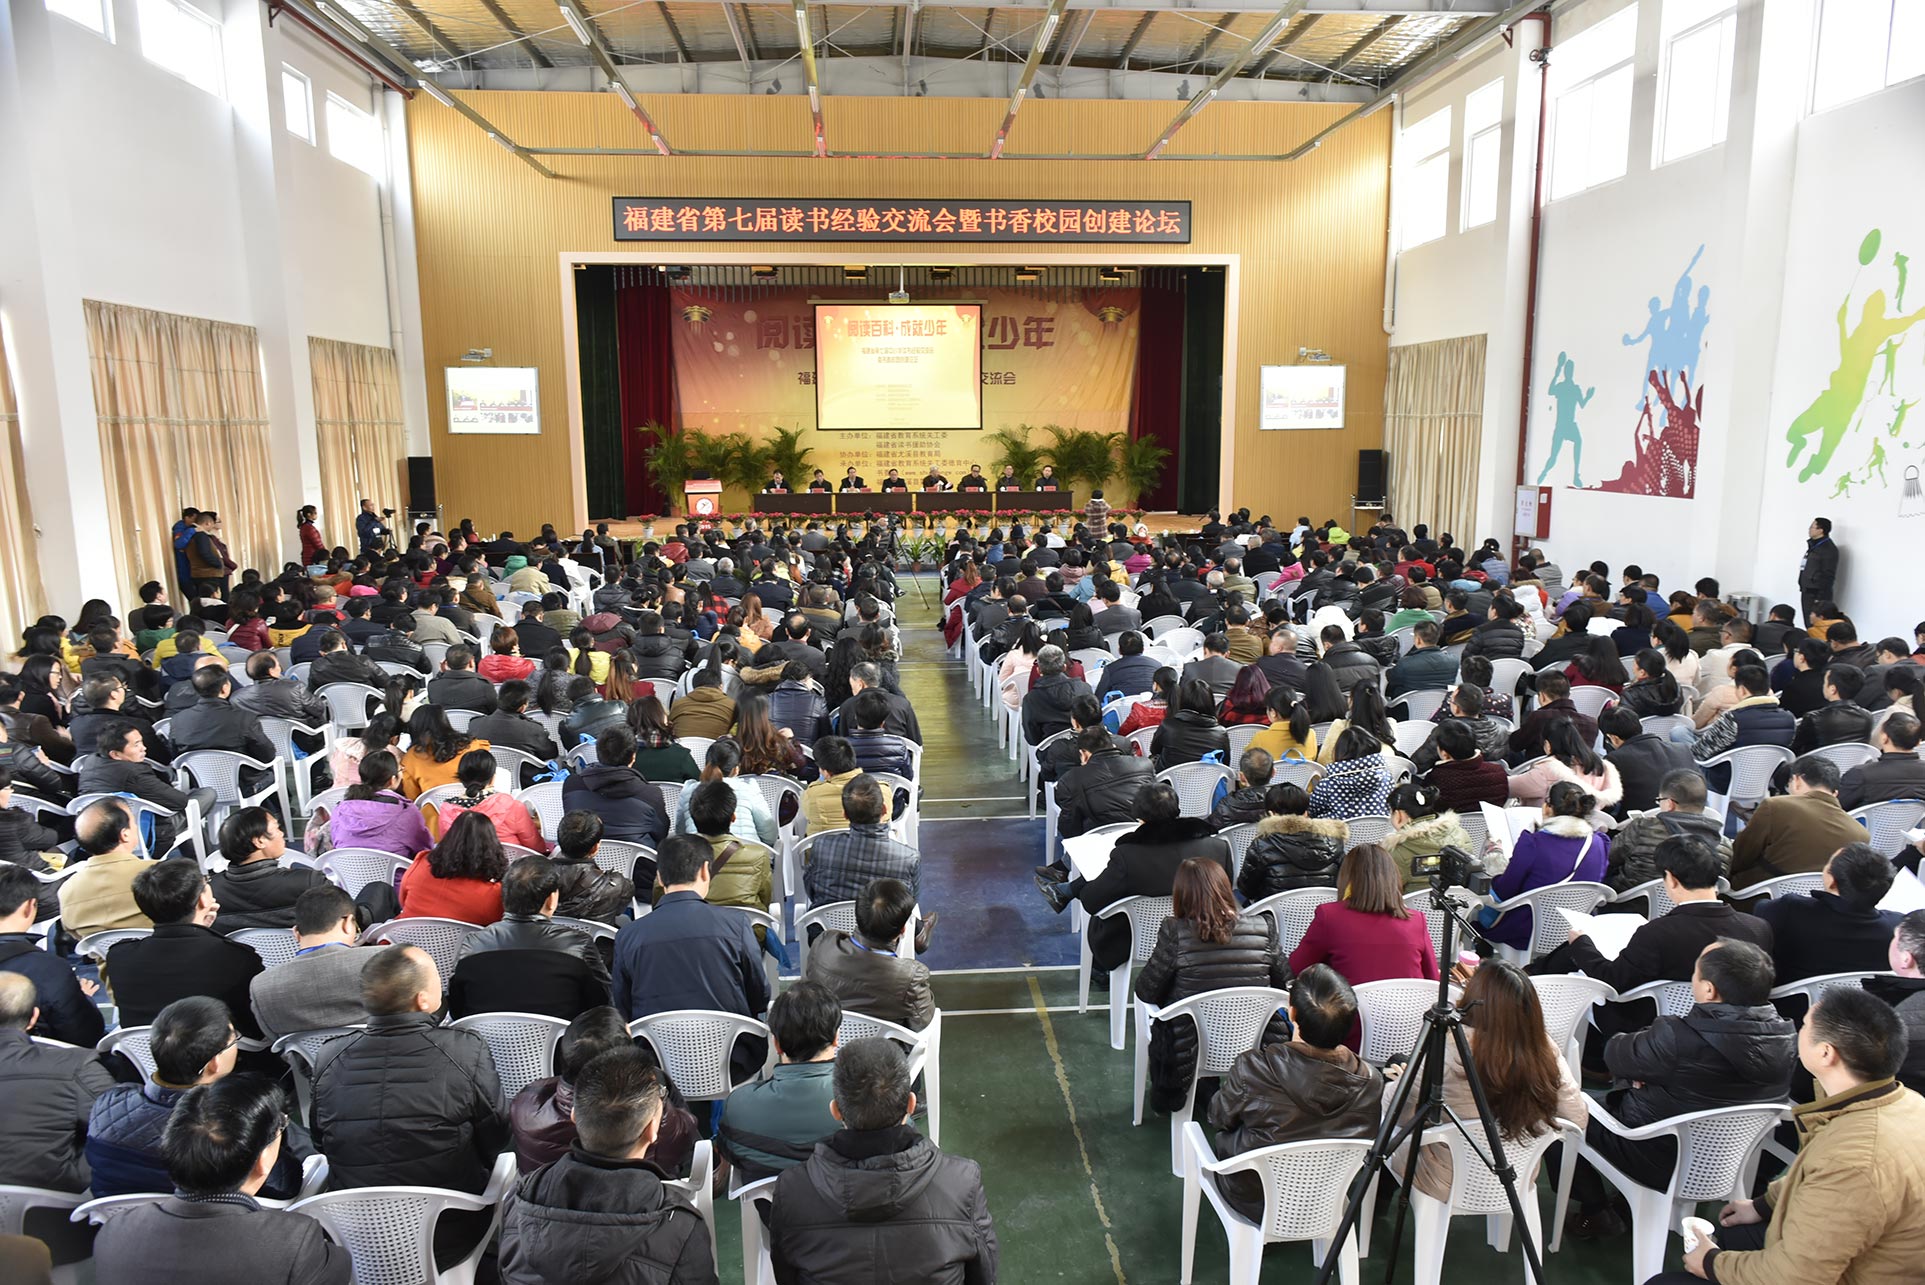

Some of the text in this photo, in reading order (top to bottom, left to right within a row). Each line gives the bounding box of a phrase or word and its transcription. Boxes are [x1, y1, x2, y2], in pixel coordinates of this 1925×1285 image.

[623, 205, 1182, 234] 福建省第七届读书经验交流会暨书香校园创建论坛
